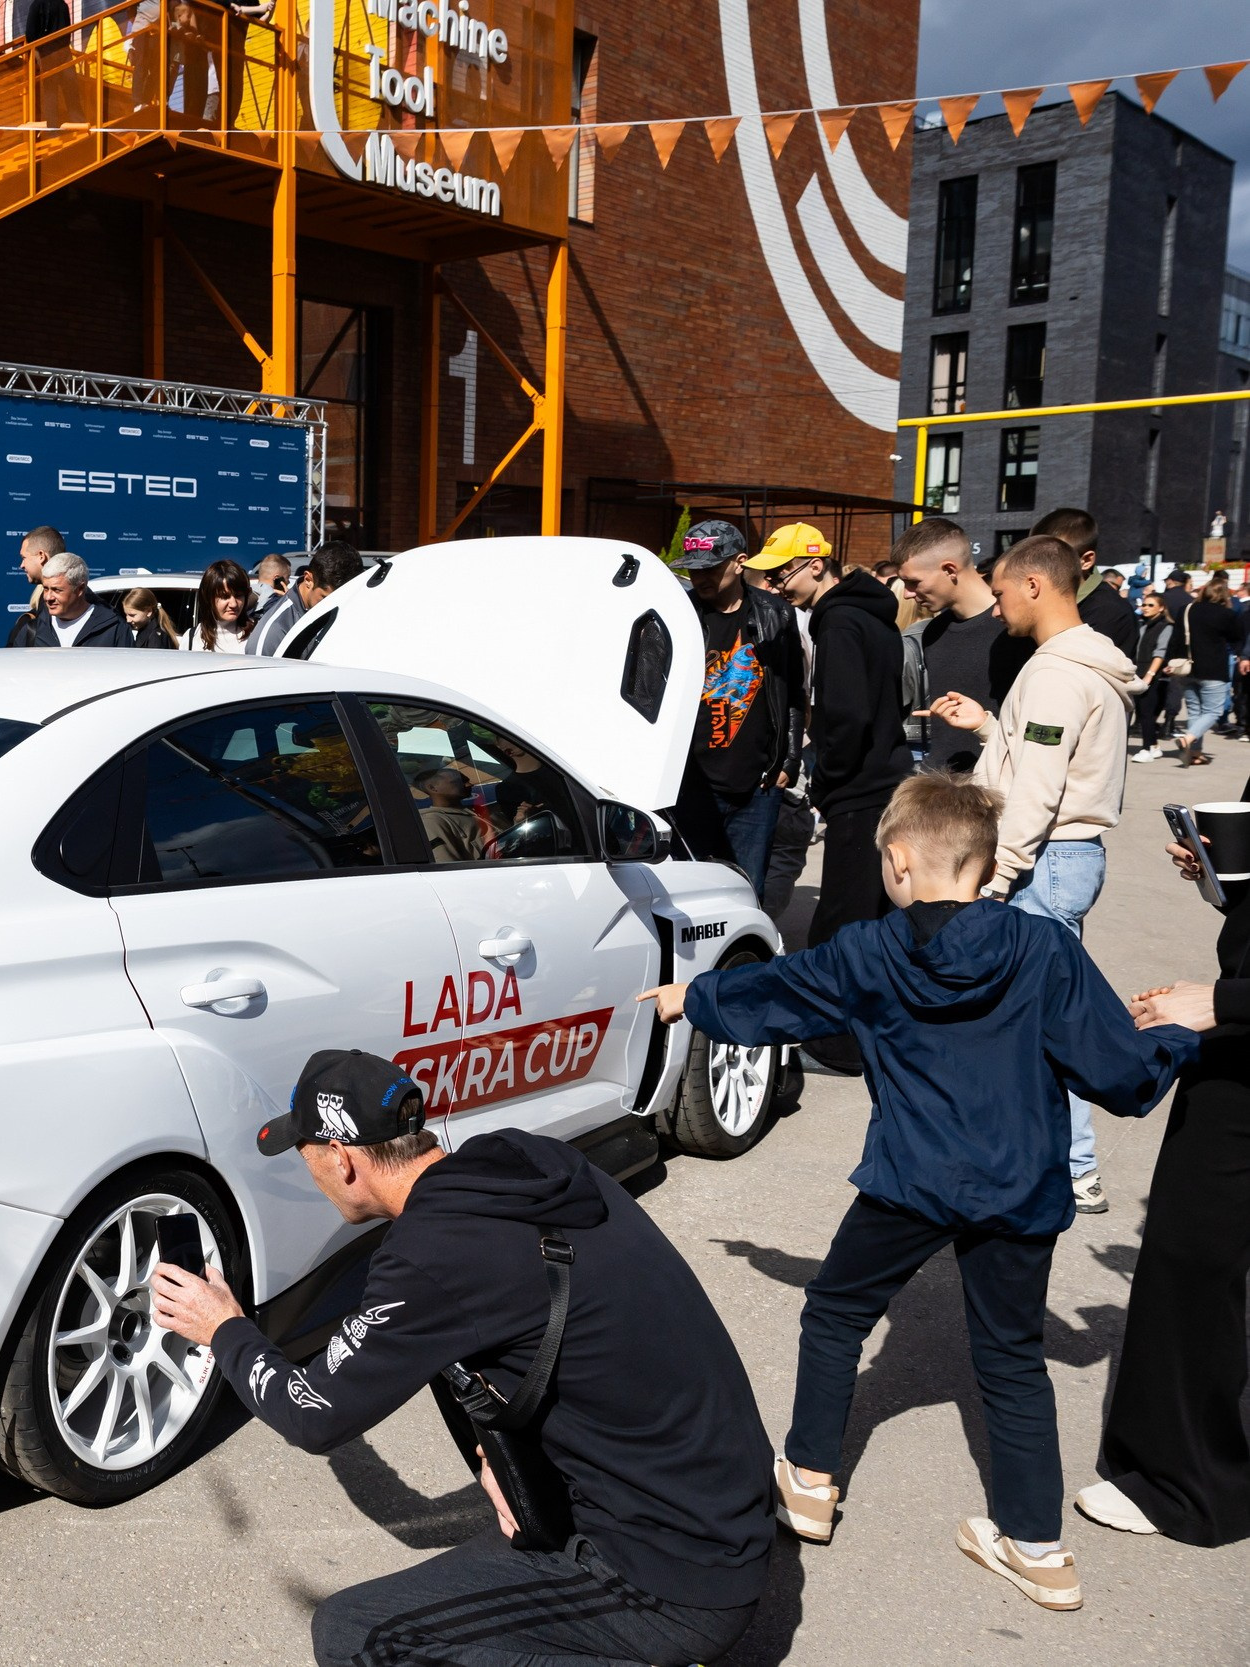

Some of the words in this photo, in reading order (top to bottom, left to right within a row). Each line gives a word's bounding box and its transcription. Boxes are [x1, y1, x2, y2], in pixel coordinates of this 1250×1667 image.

[364, 44, 435, 118] Tool
[365, 131, 500, 217] Museum
[449, 330, 478, 465] 1
[58, 469, 198, 498] ESTEO
[403, 966, 523, 1038] LADA
[524, 1021, 599, 1083] CUP
